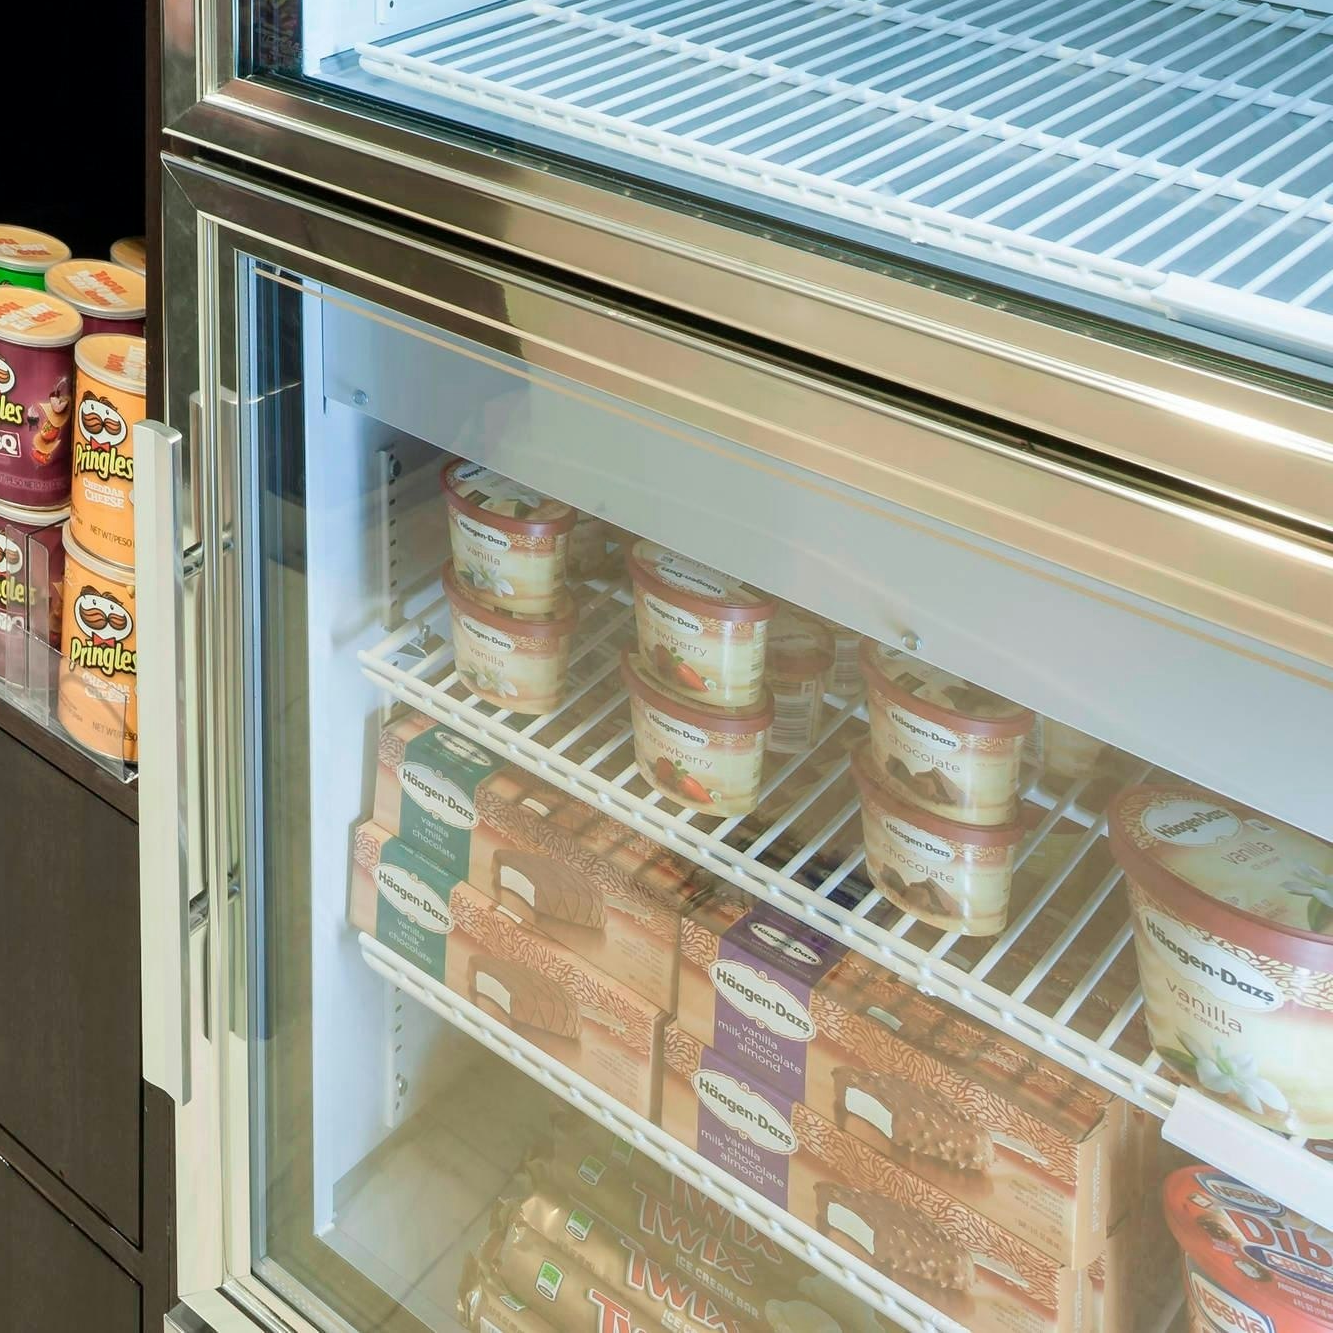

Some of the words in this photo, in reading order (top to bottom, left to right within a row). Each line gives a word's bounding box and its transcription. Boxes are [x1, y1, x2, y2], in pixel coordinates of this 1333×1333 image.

[75, 437, 133, 480] Pringles
[459, 520, 508, 549] Häagen-Dazs
[466, 544, 501, 567] vanilla
[646, 600, 699, 633] Häagen-Dazs
[462, 621, 512, 650] Häagen-Dazs
[71, 638, 136, 675] Pringles
[469, 646, 505, 667] vanilla
[648, 712, 705, 746] Häagen-Dazs
[891, 712, 957, 749] Häagen-Dazs
[644, 729, 713, 770] strawberry
[888, 732, 961, 774] chocolate
[402, 768, 475, 822] Häagen-Dazs
[421, 815, 450, 839] vanilla
[425, 827, 444, 843] milk
[886, 820, 951, 860] Häagen-Dazs
[1154, 808, 1230, 840] Häagen-Dazs
[412, 828, 456, 861] chocolate
[1221, 839, 1274, 866] vanilla
[883, 843, 955, 885] chocolate
[378, 869, 450, 927] Häagen-Dazs
[388, 930, 432, 965] chocolate
[397, 917, 426, 943] vanilla
[401, 930, 420, 947] milk
[1145, 916, 1275, 1005] Häagen-Dazs
[715, 968, 810, 1035] Häagen-Dazs
[1165, 977, 1243, 1034] vanilla
[717, 1019, 743, 1040] milk
[744, 1036, 803, 1075] chocolate
[741, 1022, 779, 1050] vanilla
[736, 1041, 781, 1074] almond
[698, 1076, 793, 1147] Häagen-Dazs
[700, 1128, 724, 1149] milk
[726, 1145, 785, 1188] chocolate
[724, 1132, 761, 1162] vanilla
[719, 1152, 765, 1186] almond
[633, 1182, 754, 1286] TWIX
[675, 1254, 693, 1269] ICE
[695, 1265, 734, 1301] CREAM
[736, 1296, 760, 1319] BAR
